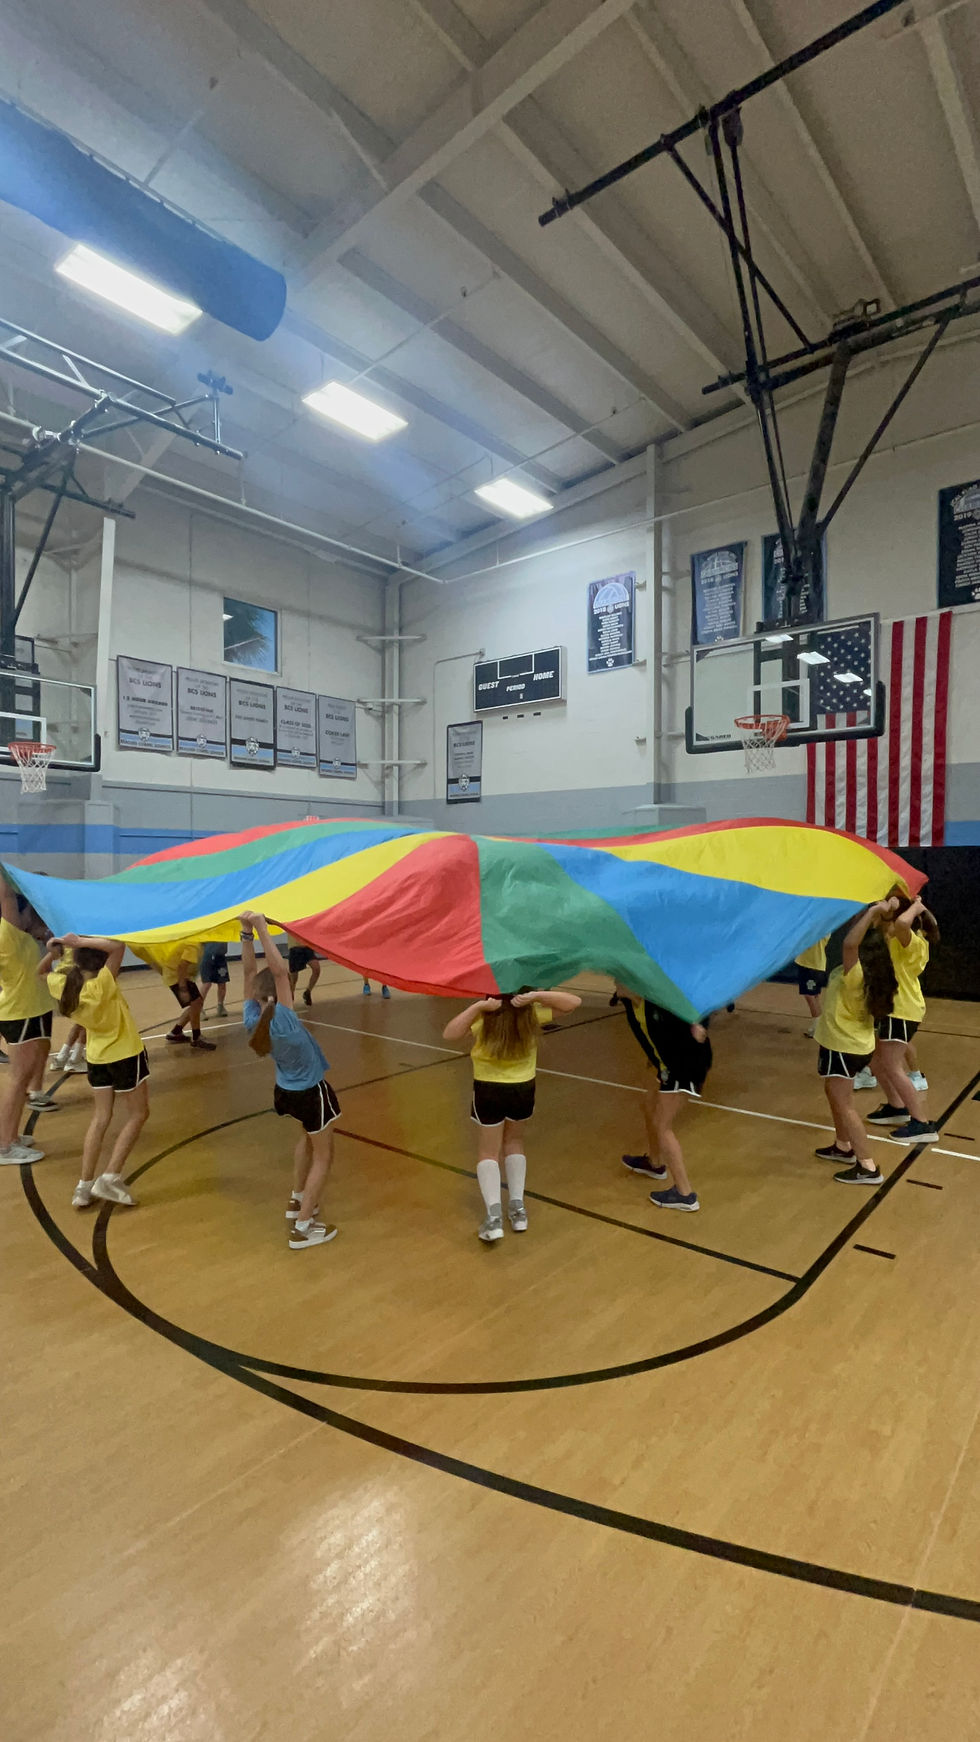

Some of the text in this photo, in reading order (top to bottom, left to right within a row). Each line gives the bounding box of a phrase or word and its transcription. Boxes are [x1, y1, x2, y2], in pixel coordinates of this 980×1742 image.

[533, 670, 555, 681] HOME
[142, 680, 162, 689] LIONS
[478, 681, 500, 691] GUEST
[506, 683, 526, 692] PERIOD
[200, 690, 217, 698] LIONS
[249, 702, 266, 710] LIONS
